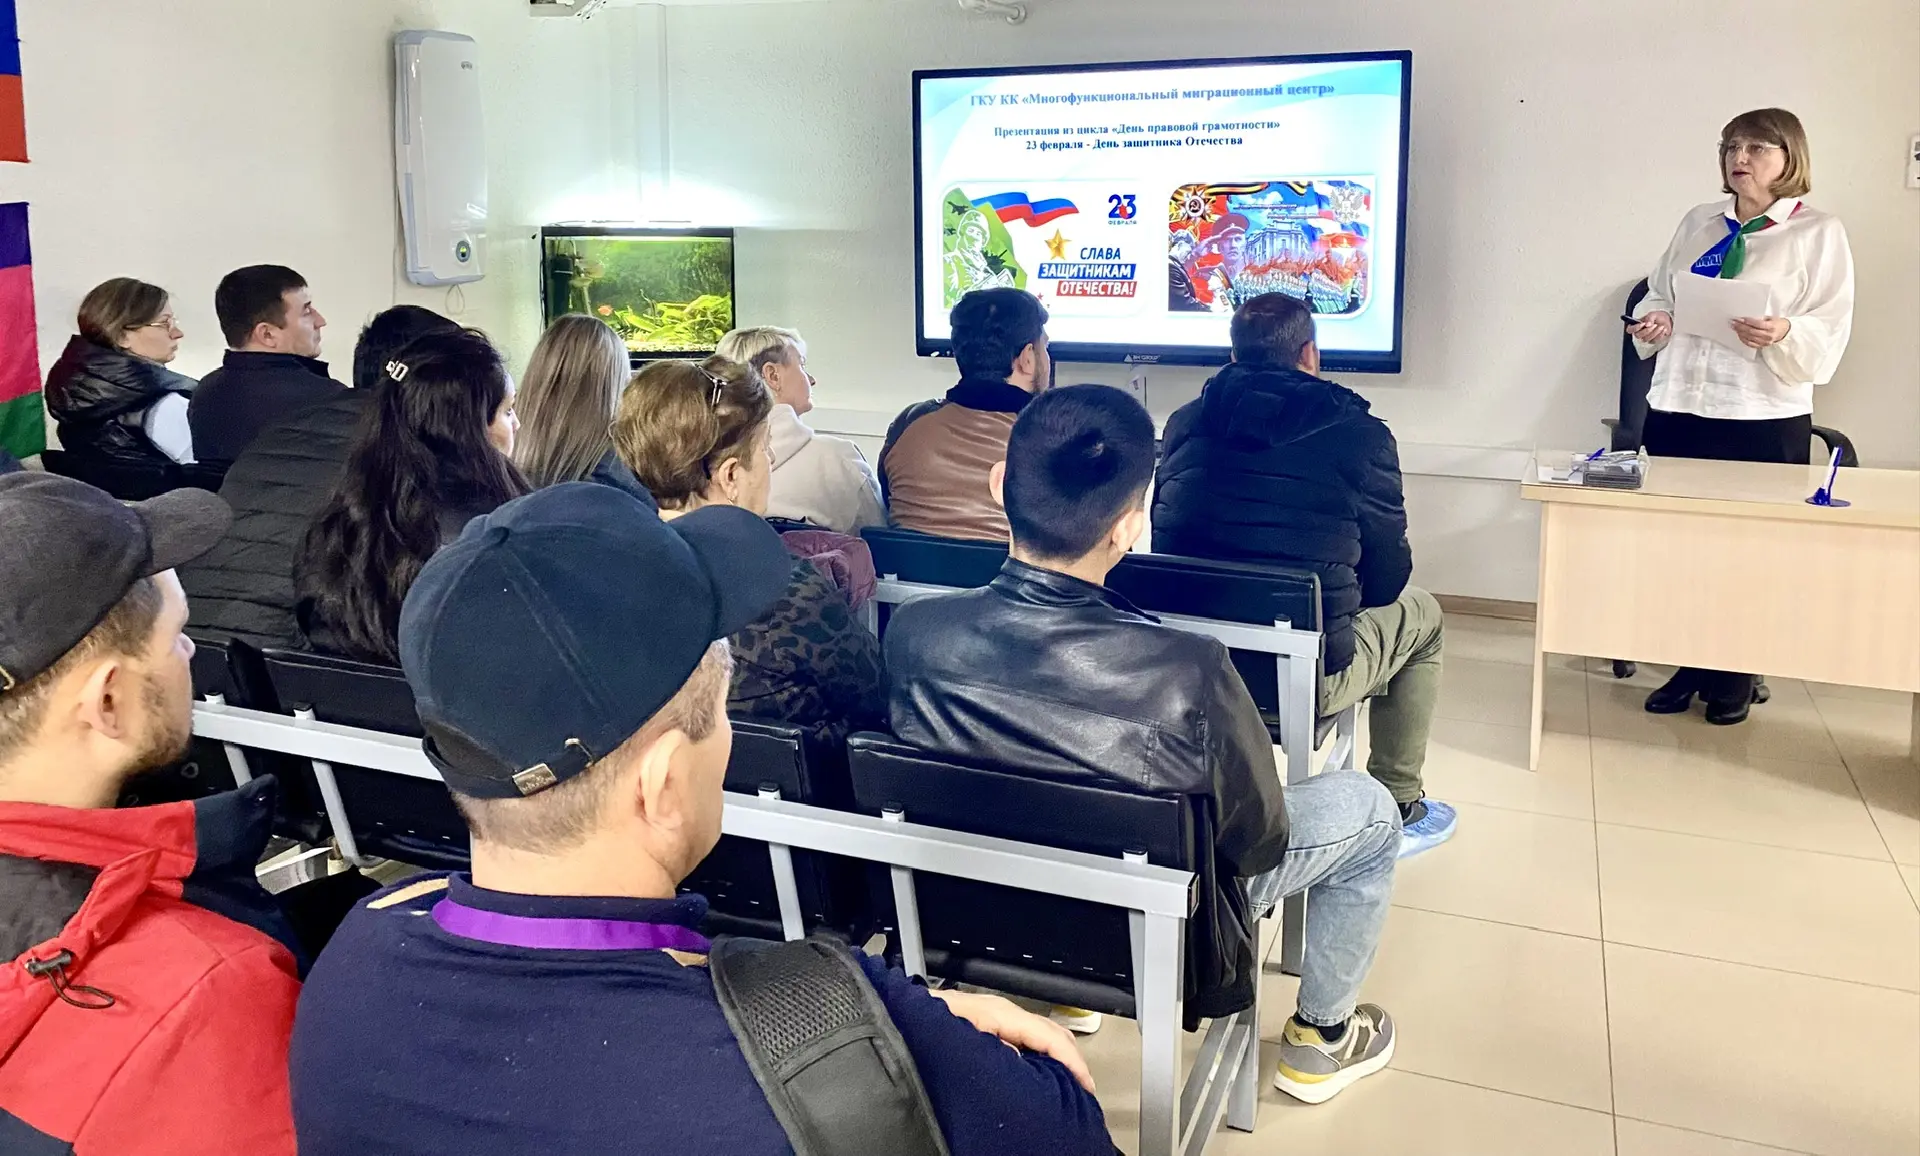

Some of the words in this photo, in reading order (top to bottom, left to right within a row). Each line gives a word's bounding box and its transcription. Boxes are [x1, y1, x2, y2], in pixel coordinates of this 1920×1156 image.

[970, 94, 997, 107] ГКУ
[1000, 94, 1019, 105] КК
[1022, 88, 1179, 105] «Многофункциональный
[1182, 84, 1283, 101] миграционный
[1287, 84, 1335, 97] центр»
[994, 126, 1060, 139] Презентация
[1063, 127, 1074, 135] из
[1077, 126, 1109, 136] цикла
[1112, 123, 1145, 135] «День
[1147, 121, 1198, 134] правовой
[1202, 120, 1280, 133] грамотности»
[1026, 140, 1037, 150] 23
[1040, 139, 1083, 151] февраля
[1093, 139, 1120, 149] День
[1123, 138, 1182, 149] защитника
[1185, 136, 1243, 147] Отечества
[1108, 194, 1137, 219] 23
[1080, 247, 1121, 260] СЛАВА
[1040, 263, 1131, 279] ЗАЩИТНИКАМ
[1059, 281, 1134, 296] ОТЕЧЕСТВА!
